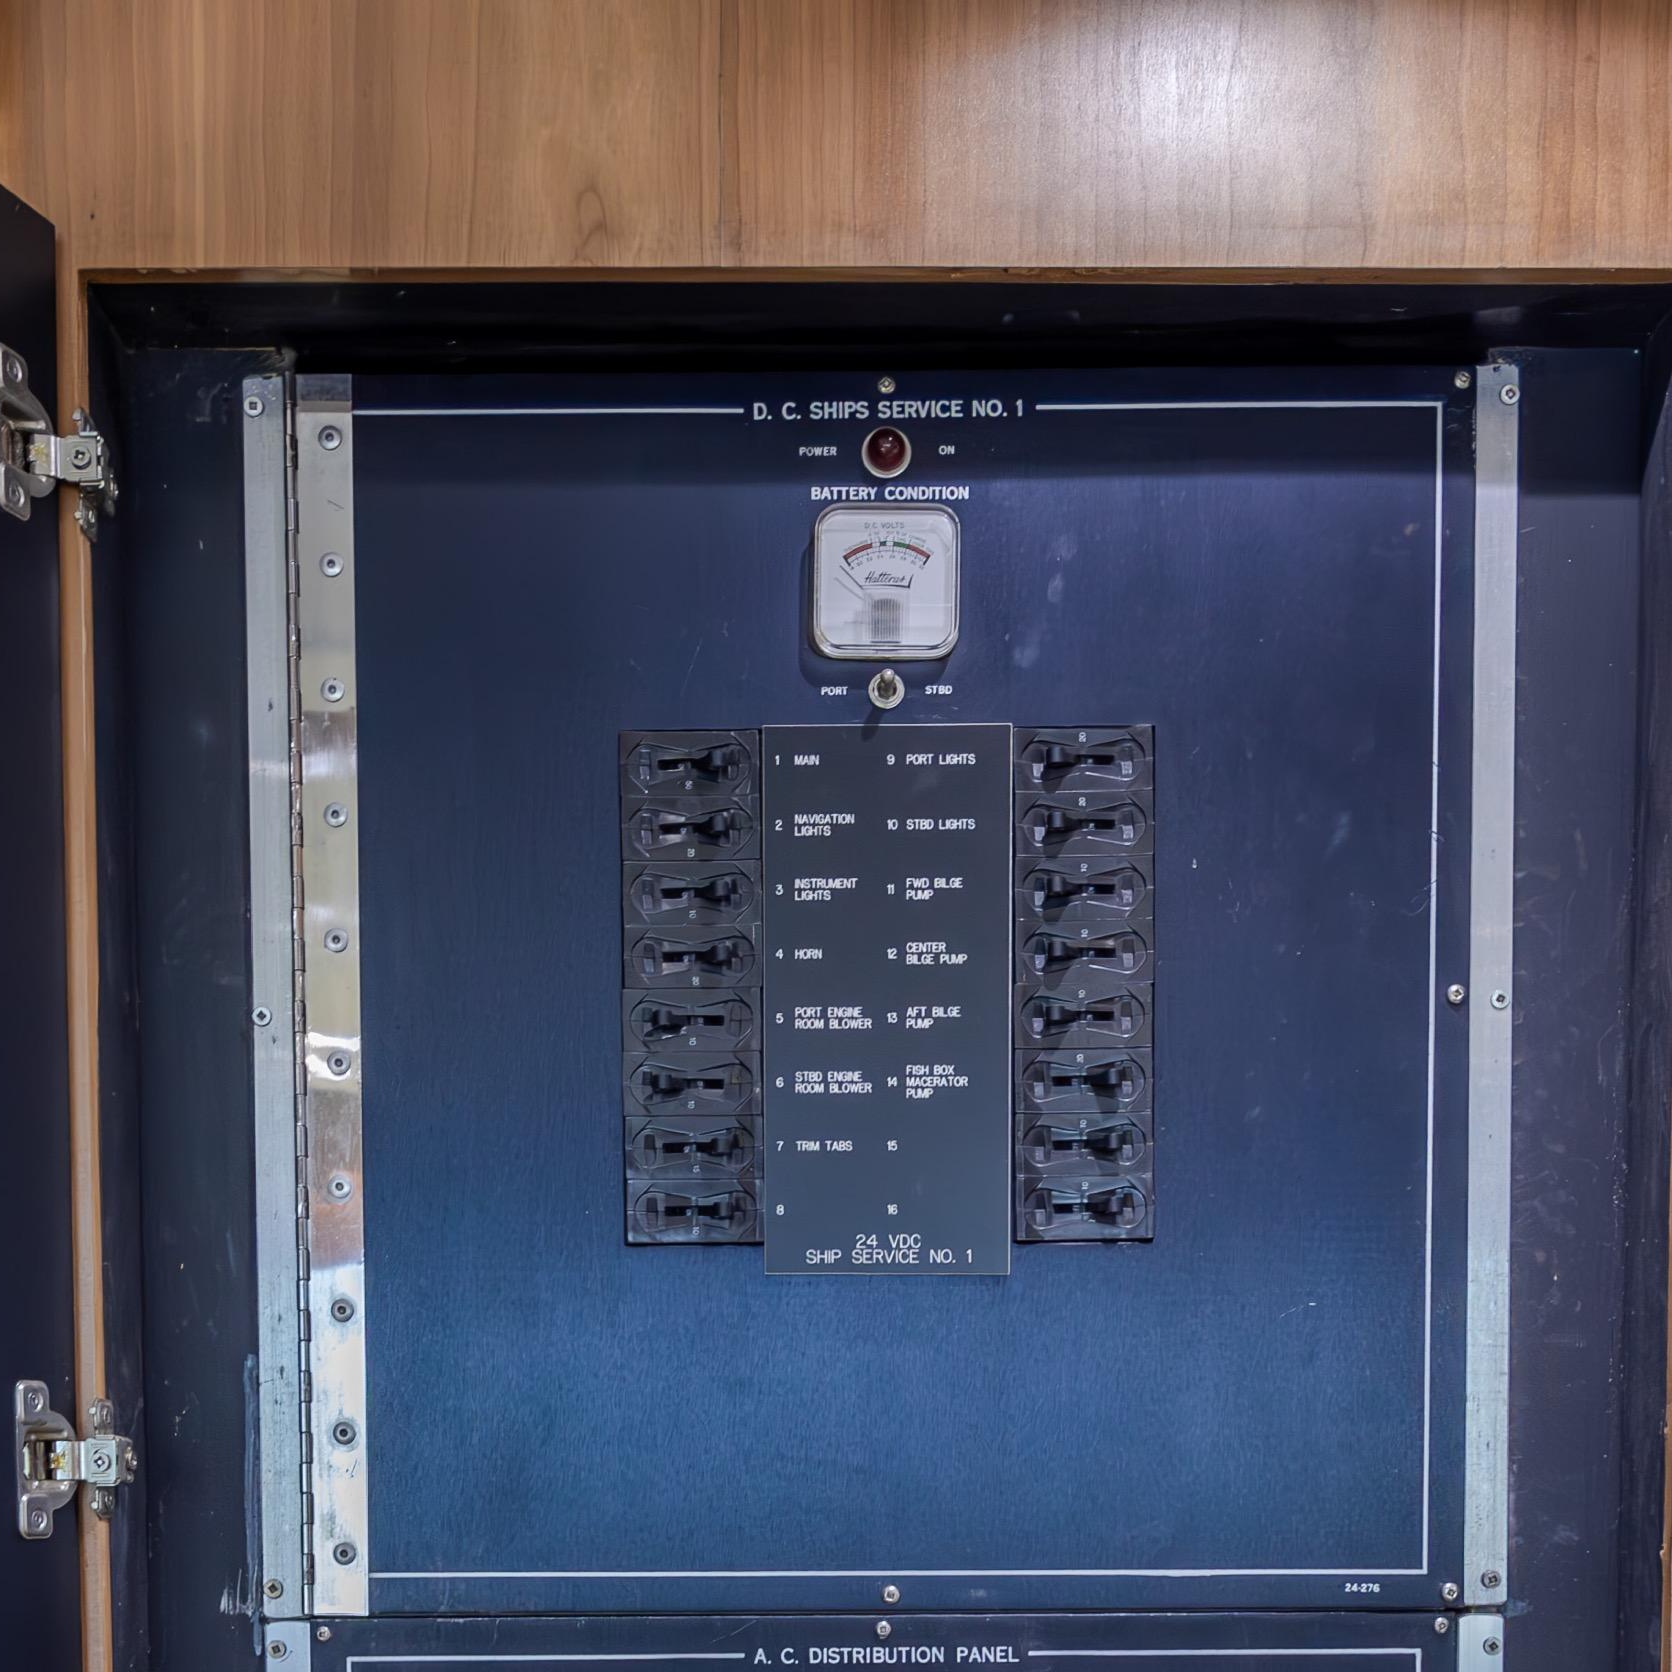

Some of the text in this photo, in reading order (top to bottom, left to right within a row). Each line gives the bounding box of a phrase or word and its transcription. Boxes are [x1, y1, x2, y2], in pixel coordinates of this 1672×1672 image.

[753, 398, 1023, 421] D. C. SHIPS SERVICE NO. 1
[798, 446, 838, 457] POWER
[938, 445, 955, 456] ON
[810, 485, 970, 501] BATTERY CONDITION
[820, 686, 848, 696] PORT
[924, 684, 953, 695] STBD
[775, 754, 780, 766] 1
[794, 754, 820, 766] MAIN
[886, 753, 896, 766] 9
[905, 753, 977, 766] PORT LIGHTS
[775, 819, 783, 831] 2
[794, 813, 855, 825] NAVIGATION
[886, 818, 899, 831] 10
[906, 818, 976, 831] STBD LIGHTS
[794, 824, 832, 837] LIGHTS
[794, 877, 859, 890] INSTRUMENT
[886, 883, 895, 895] 11
[905, 877, 964, 889] FWD BILGE
[775, 884, 784, 896] 3
[794, 889, 832, 901] LIGHTS
[905, 888, 934, 901] PUMP
[886, 947, 898, 960] 12
[905, 941, 947, 954] CENTER
[775, 948, 784, 960] 4
[794, 948, 823, 960] HORN
[905, 953, 968, 965] BILGE PUMP
[794, 1006, 863, 1019] PORT ENGINE
[906, 1005, 962, 1018] AFT BILGE
[775, 1012, 784, 1024] 5
[794, 1017, 873, 1030] ROOM BLOWER
[886, 1012, 898, 1024] 13
[905, 1017, 934, 1029] PUMP
[905, 1064, 955, 1076] FISH BOX
[775, 1076, 785, 1088] 6
[795, 1070, 863, 1083] STBD ENGINE
[886, 1076, 898, 1088] 14
[905, 1075, 969, 1088] MACERATOR
[794, 1082, 873, 1094] ROOM BLOWER
[905, 1087, 934, 1099] PUMP
[776, 1140, 785, 1152] 7
[795, 1140, 853, 1152] TRIM TABS
[886, 1139, 898, 1152] 15
[775, 1204, 785, 1216] 8
[887, 1203, 898, 1215] 16
[855, 1233, 922, 1249] 24 VDC
[805, 1248, 972, 1265] SHIP SERVICE NO. 1
[753, 1645, 1020, 1665] A. C. DISTRIBUTION PANEL
